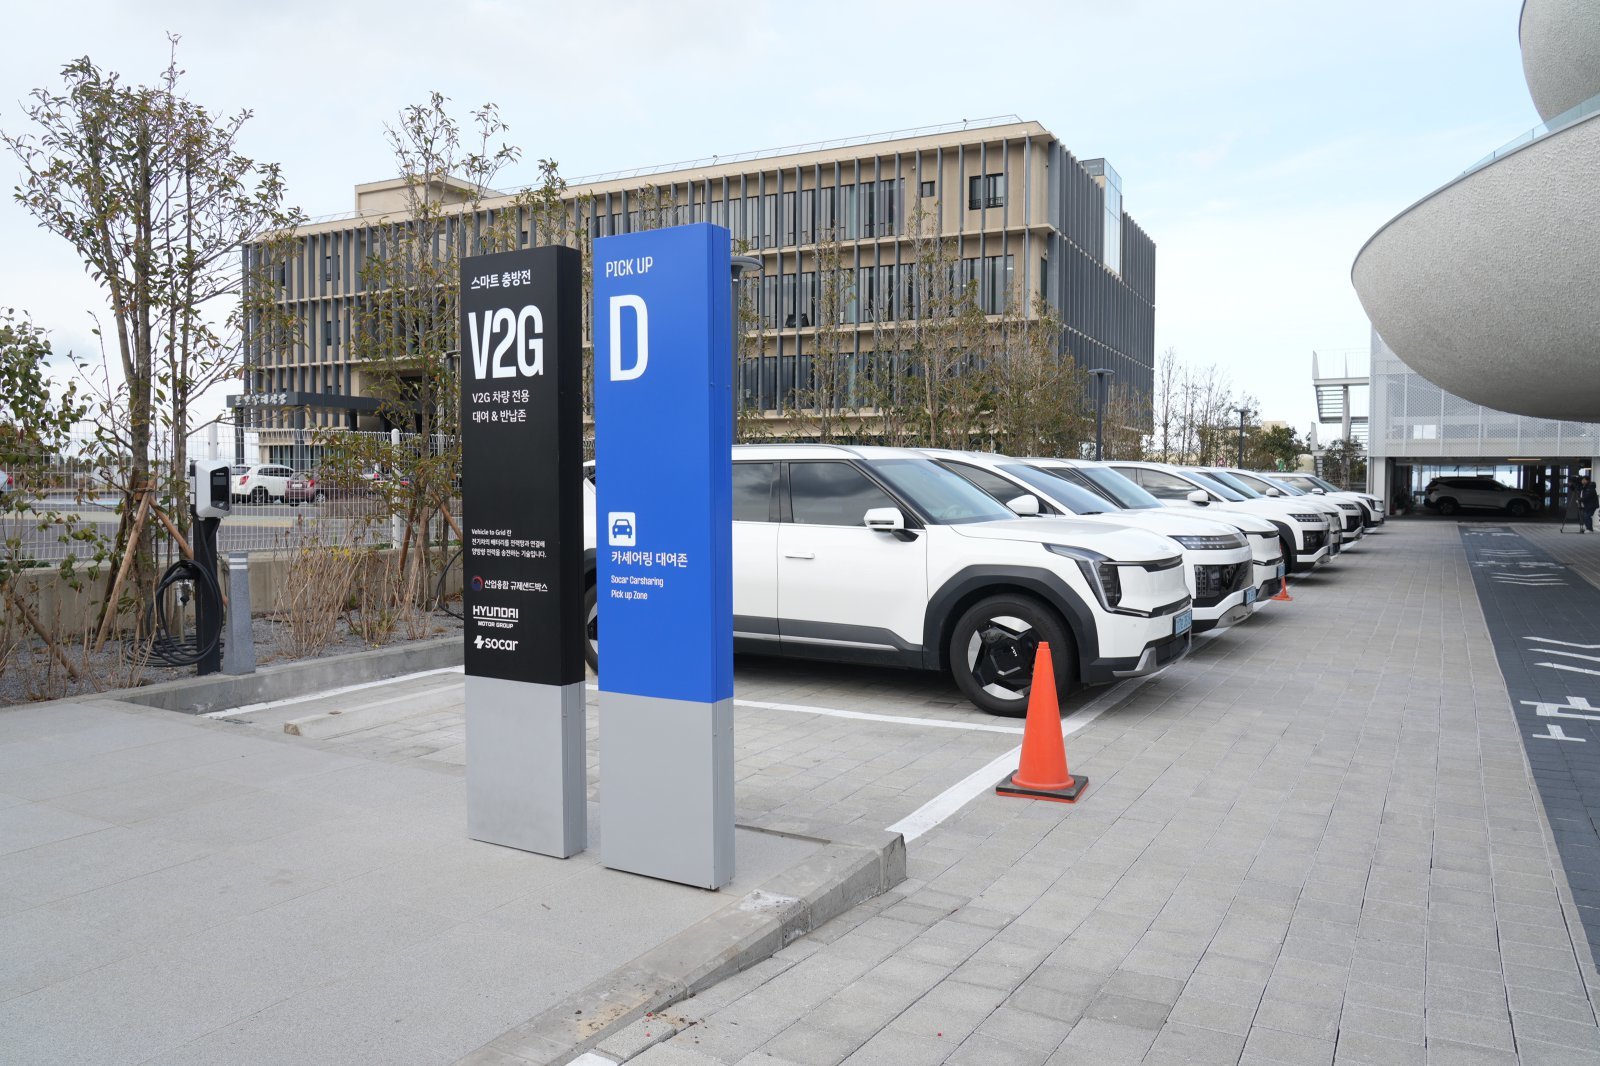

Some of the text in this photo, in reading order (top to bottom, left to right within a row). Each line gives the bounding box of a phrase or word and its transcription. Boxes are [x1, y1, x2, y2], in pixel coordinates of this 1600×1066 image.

[606, 256, 654, 278] PICK UP
[470, 268, 531, 290] 스마트 충방전
[468, 304, 544, 380] V2G
[609, 294, 649, 382] D
[472, 389, 530, 404] V2G 차량 전용
[472, 409, 527, 423] 대여 & 반납존
[655, 552, 689, 568] 대여존
[484, 579, 509, 590] 산업융합
[611, 574, 664, 588] Socar Carsharing
[611, 589, 648, 600] Pick up Zone
[472, 605, 519, 619] HYUNDAI
[477, 620, 495, 628] MOTOR
[484, 637, 519, 651] socar
